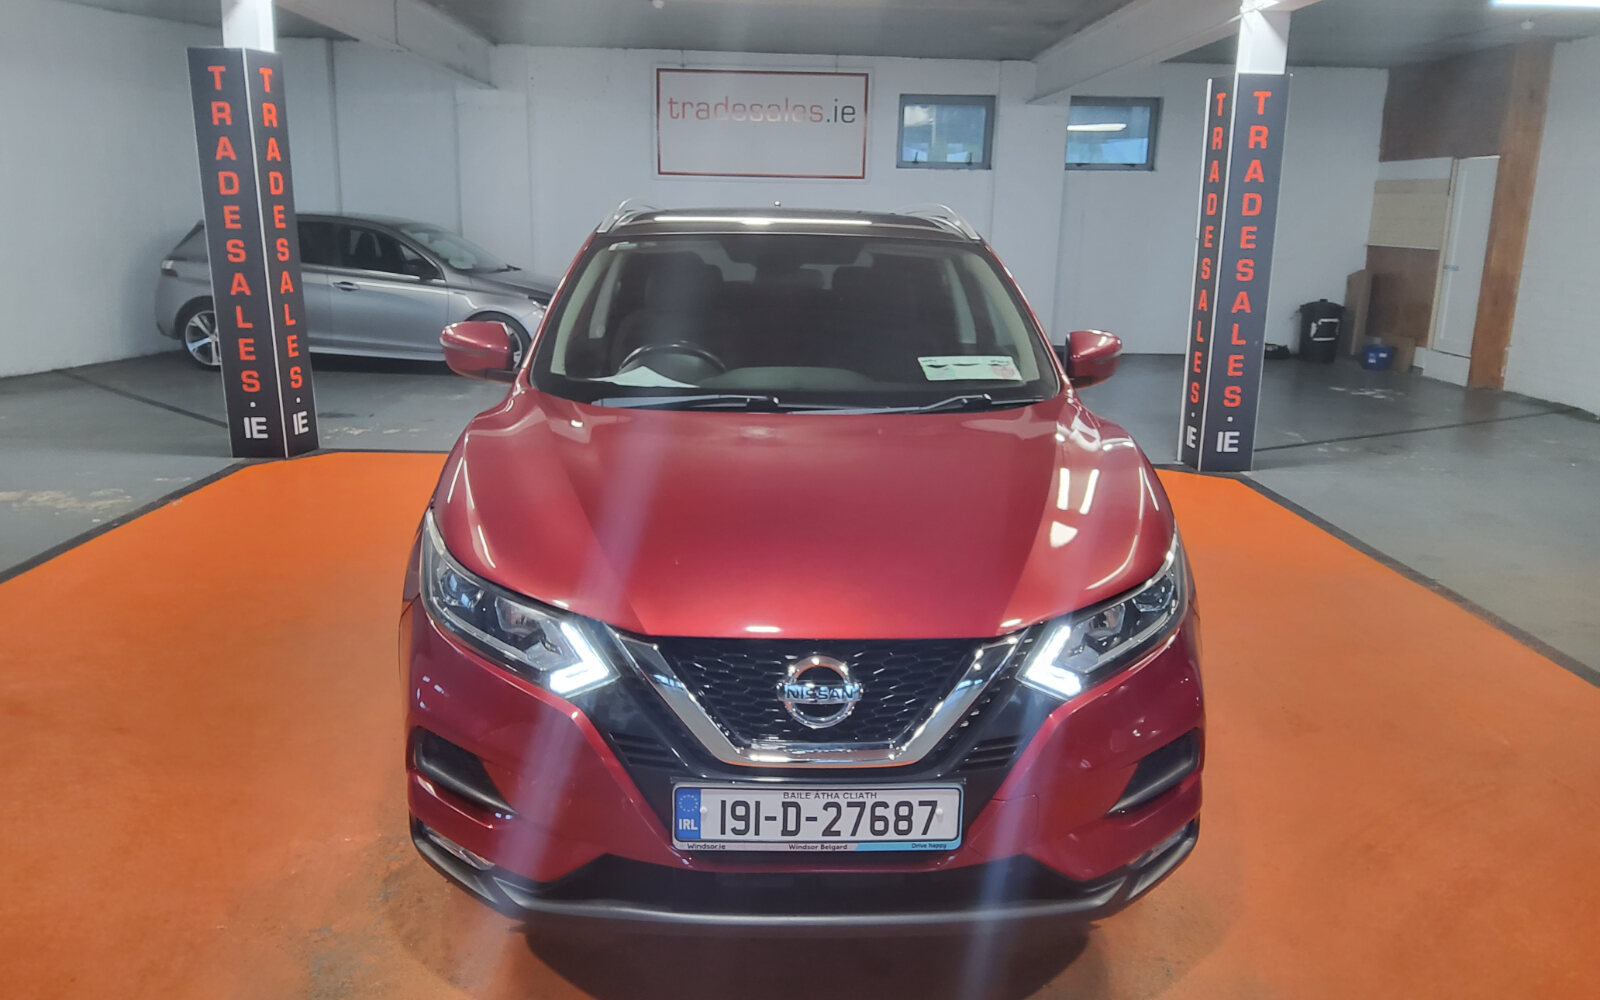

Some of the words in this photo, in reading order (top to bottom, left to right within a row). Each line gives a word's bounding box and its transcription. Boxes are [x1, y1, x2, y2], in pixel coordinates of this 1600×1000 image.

[667, 96, 857, 124] tradesales.ie
[785, 687, 855, 701] NISSAN
[783, 791, 812, 800] BAILE
[842, 791, 878, 800] CLIATH
[678, 818, 699, 831] IRL
[720, 799, 938, 837] 191-D-27687
[687, 842, 726, 850] Windsor.ie
[820, 843, 848, 852] Belgard
